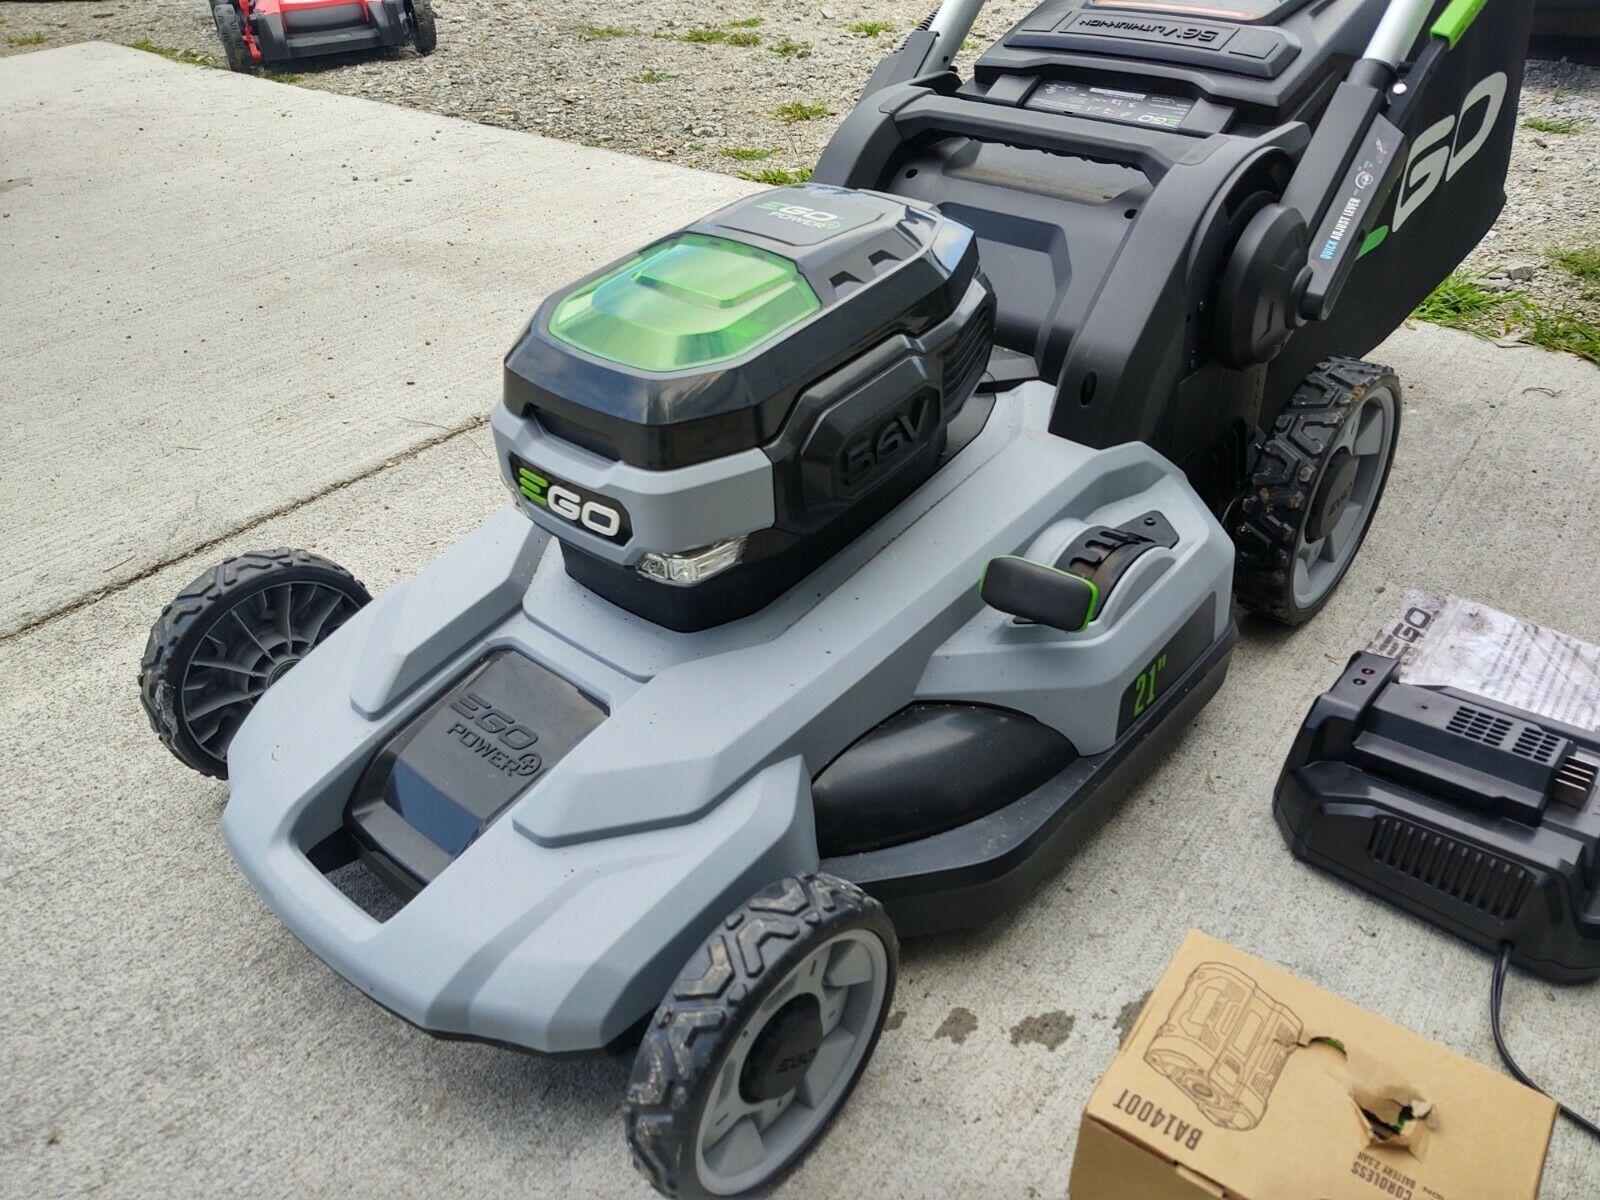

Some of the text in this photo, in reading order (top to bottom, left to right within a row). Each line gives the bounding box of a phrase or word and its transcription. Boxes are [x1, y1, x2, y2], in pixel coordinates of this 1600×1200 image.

[1162, 28, 1219, 43] 56V
[1138, 114, 1182, 129] EGO
[1356, 72, 1508, 261] GO
[756, 201, 838, 222] EGO
[1320, 196, 1362, 260] QUICK ADJUST LEVER
[841, 396, 931, 487] 56V
[519, 467, 621, 537] EGO
[1378, 606, 1432, 662] EGO
[450, 692, 539, 750] EGO
[1112, 1089, 1203, 1151] BA1400T
[1351, 1161, 1412, 1200] CORDLESS
[1382, 1165, 1417, 1190] BATTERY
